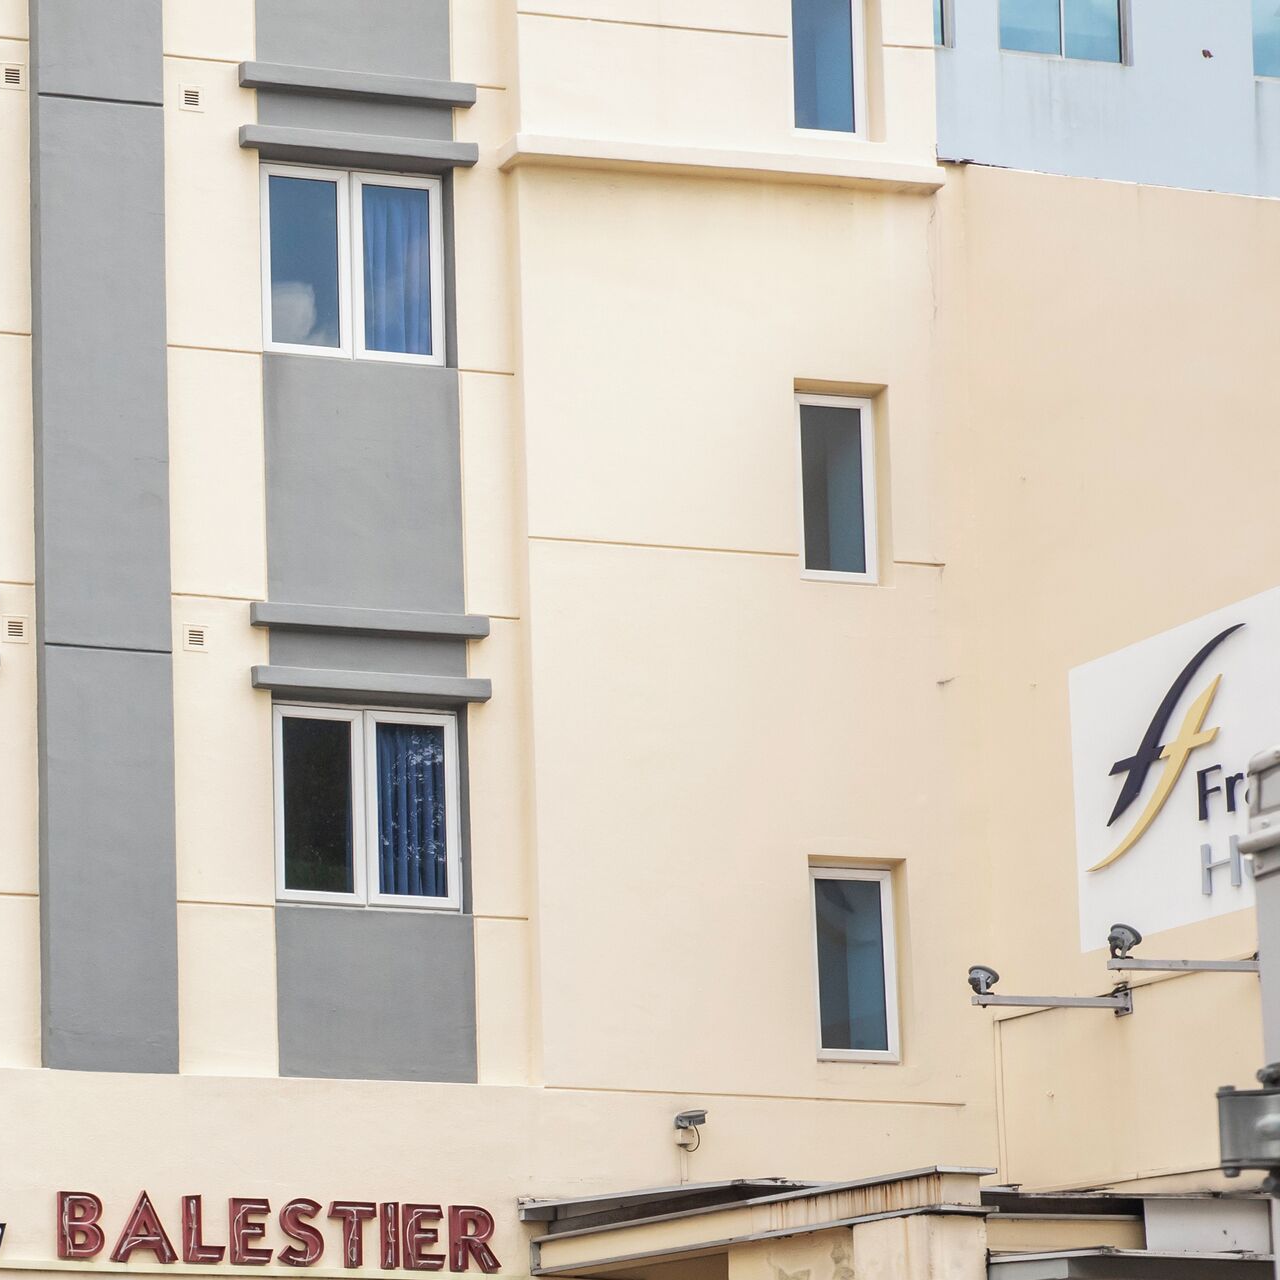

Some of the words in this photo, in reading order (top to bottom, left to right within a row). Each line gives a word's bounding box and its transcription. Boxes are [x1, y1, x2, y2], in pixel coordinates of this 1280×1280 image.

[1197, 764, 1250, 821] Fr
[1200, 834, 1255, 895] H
[56, 1190, 502, 1273] BALESTIER
